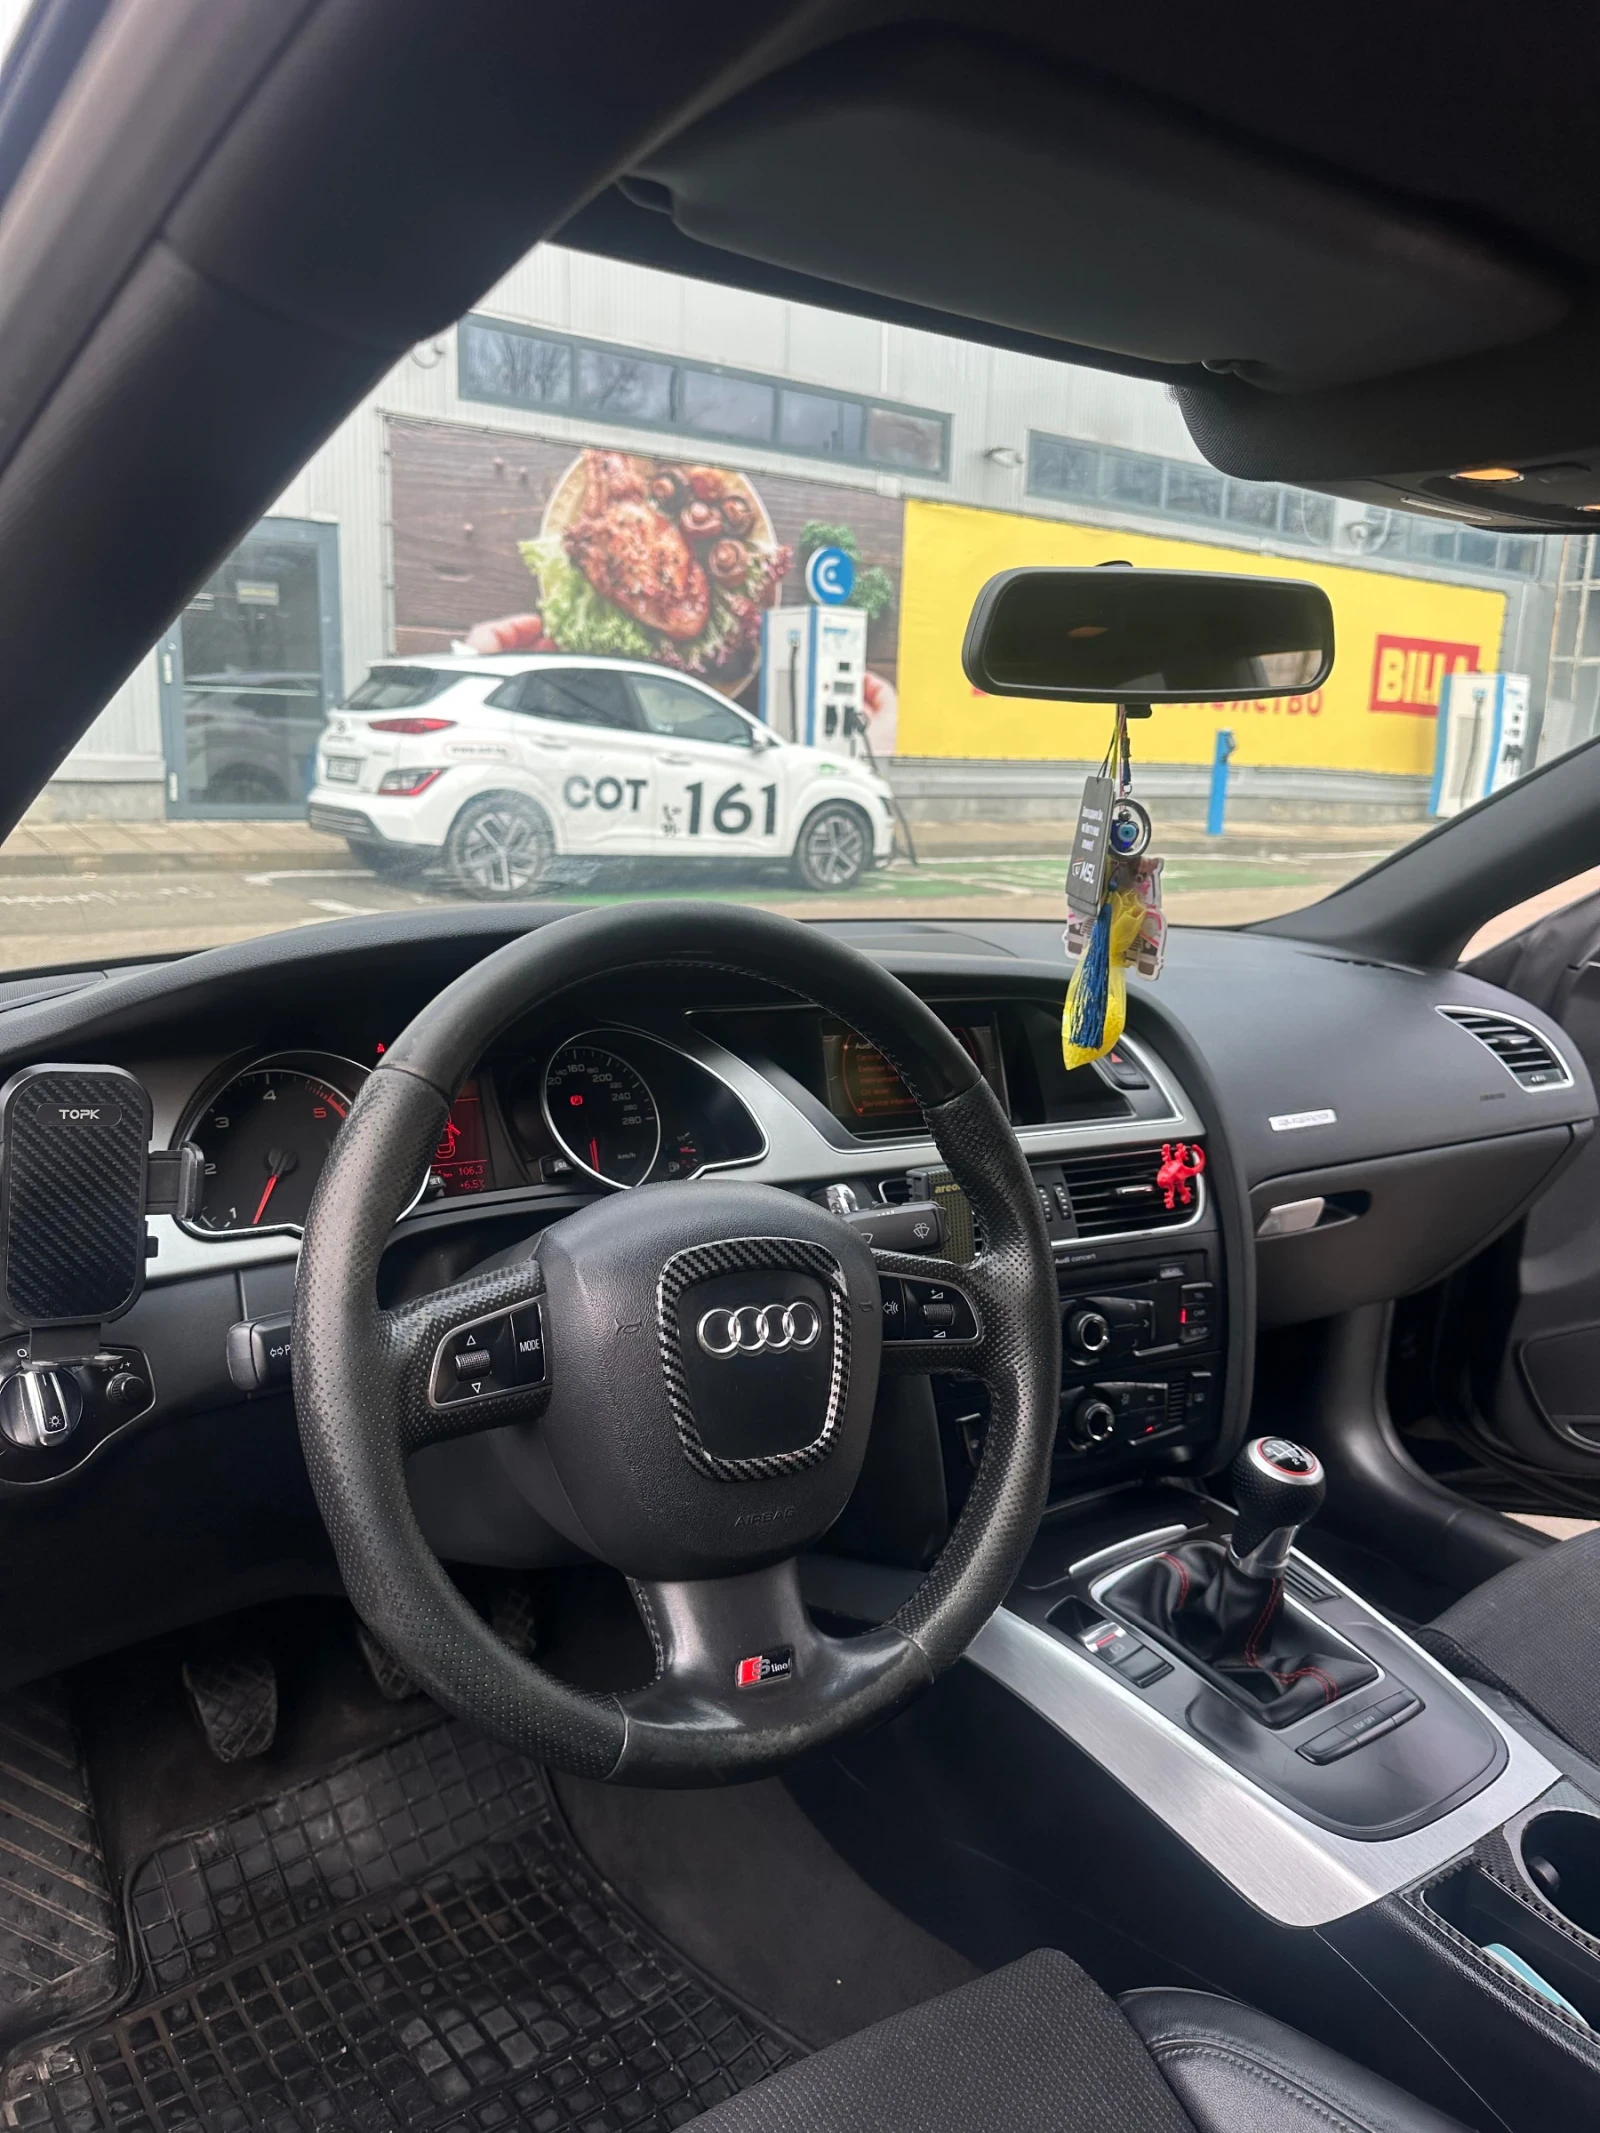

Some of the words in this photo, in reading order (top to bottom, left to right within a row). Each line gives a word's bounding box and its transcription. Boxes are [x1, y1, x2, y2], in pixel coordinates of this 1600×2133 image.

[685, 781, 778, 836] 161
[592, 1073, 613, 1083] 200
[263, 1089, 277, 1101] 4
[611, 1092, 632, 1102] 240
[58, 1109, 100, 1120] TOPK
[313, 1107, 327, 1119] 5
[214, 1117, 230, 1129] 3
[204, 1162, 217, 1175] 2
[458, 1165, 484, 1176] 106.3
[430, 1177, 441, 1185] SET
[229, 1207, 238, 1219] 1
[519, 1338, 541, 1353] MODE
[733, 1507, 795, 1527] AIRBAG
[752, 1658, 771, 1677] S
